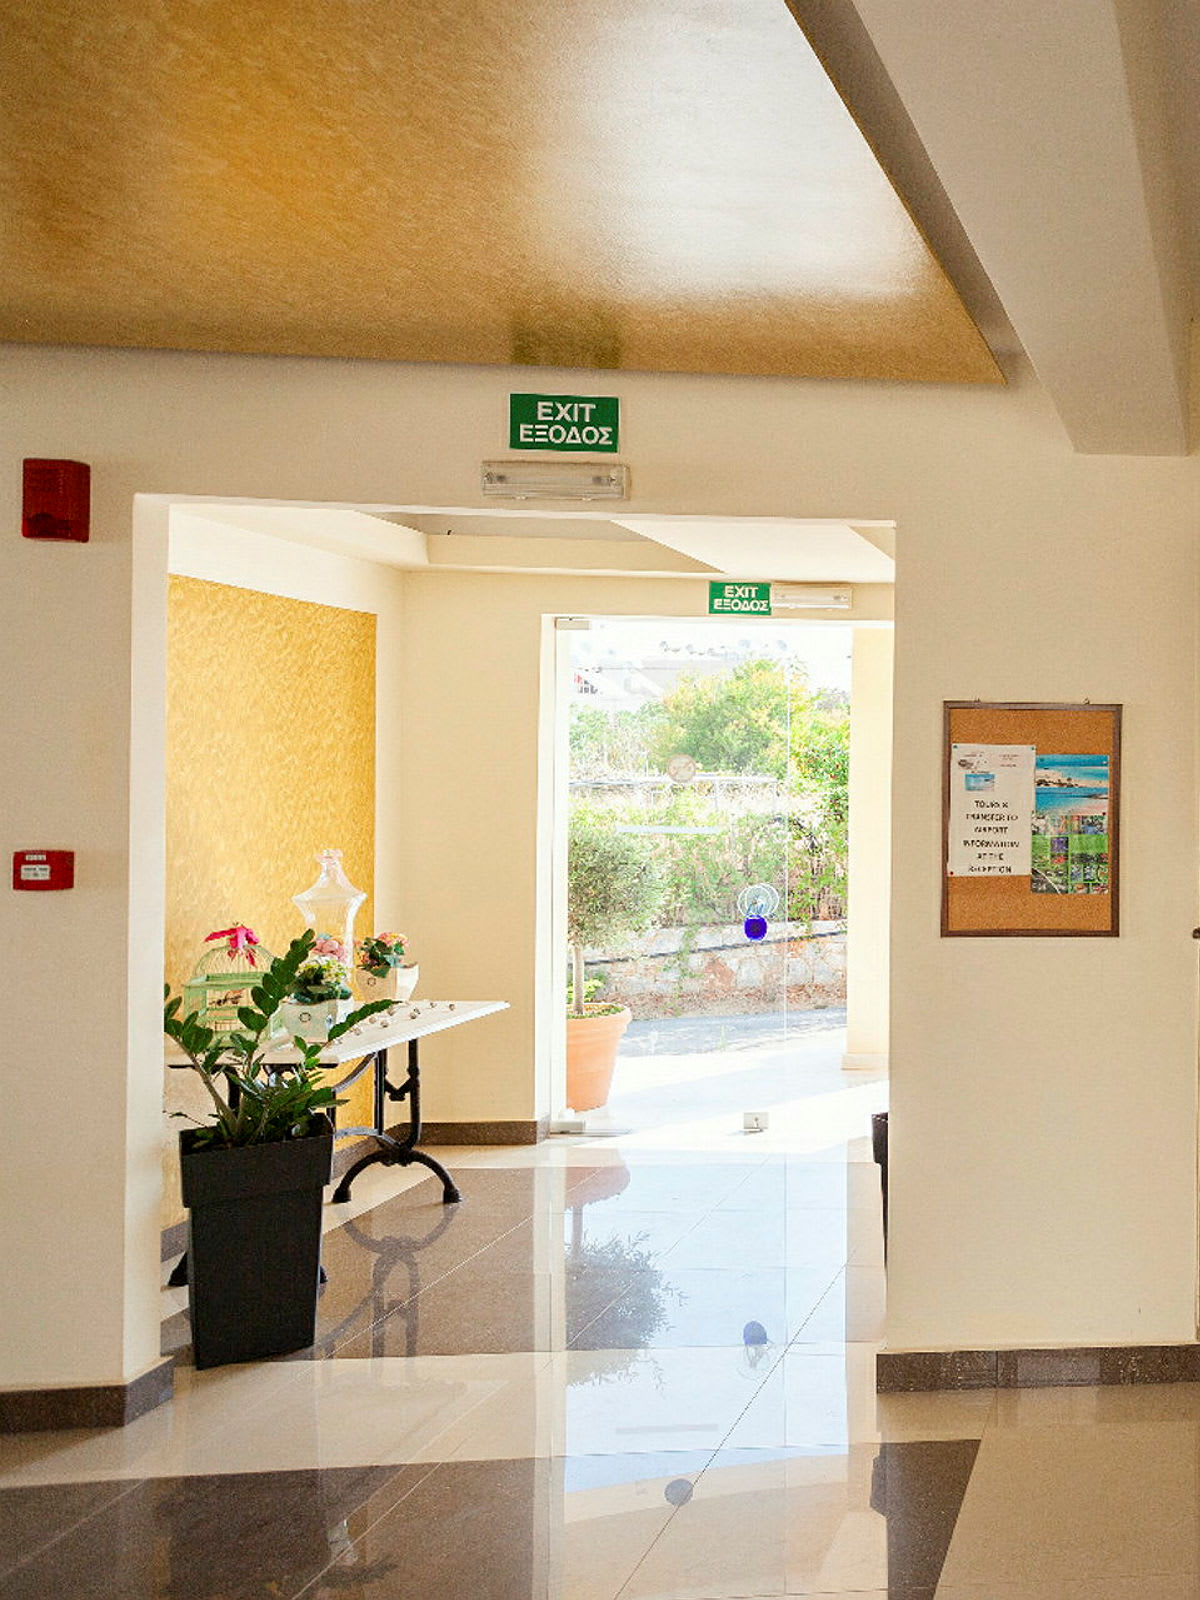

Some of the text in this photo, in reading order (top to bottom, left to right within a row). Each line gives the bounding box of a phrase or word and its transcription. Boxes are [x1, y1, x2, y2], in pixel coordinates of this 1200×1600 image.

[537, 401, 596, 422] EXIT
[519, 423, 613, 445] ΕΞΟΔΟΣ
[724, 585, 759, 599] EXIT
[713, 598, 769, 612] ΕΞΟΔΟΣ
[974, 826, 1009, 834] AIRPORT
[963, 839, 1020, 848] INFORMATION
[968, 865, 1013, 874] RECEPTION
